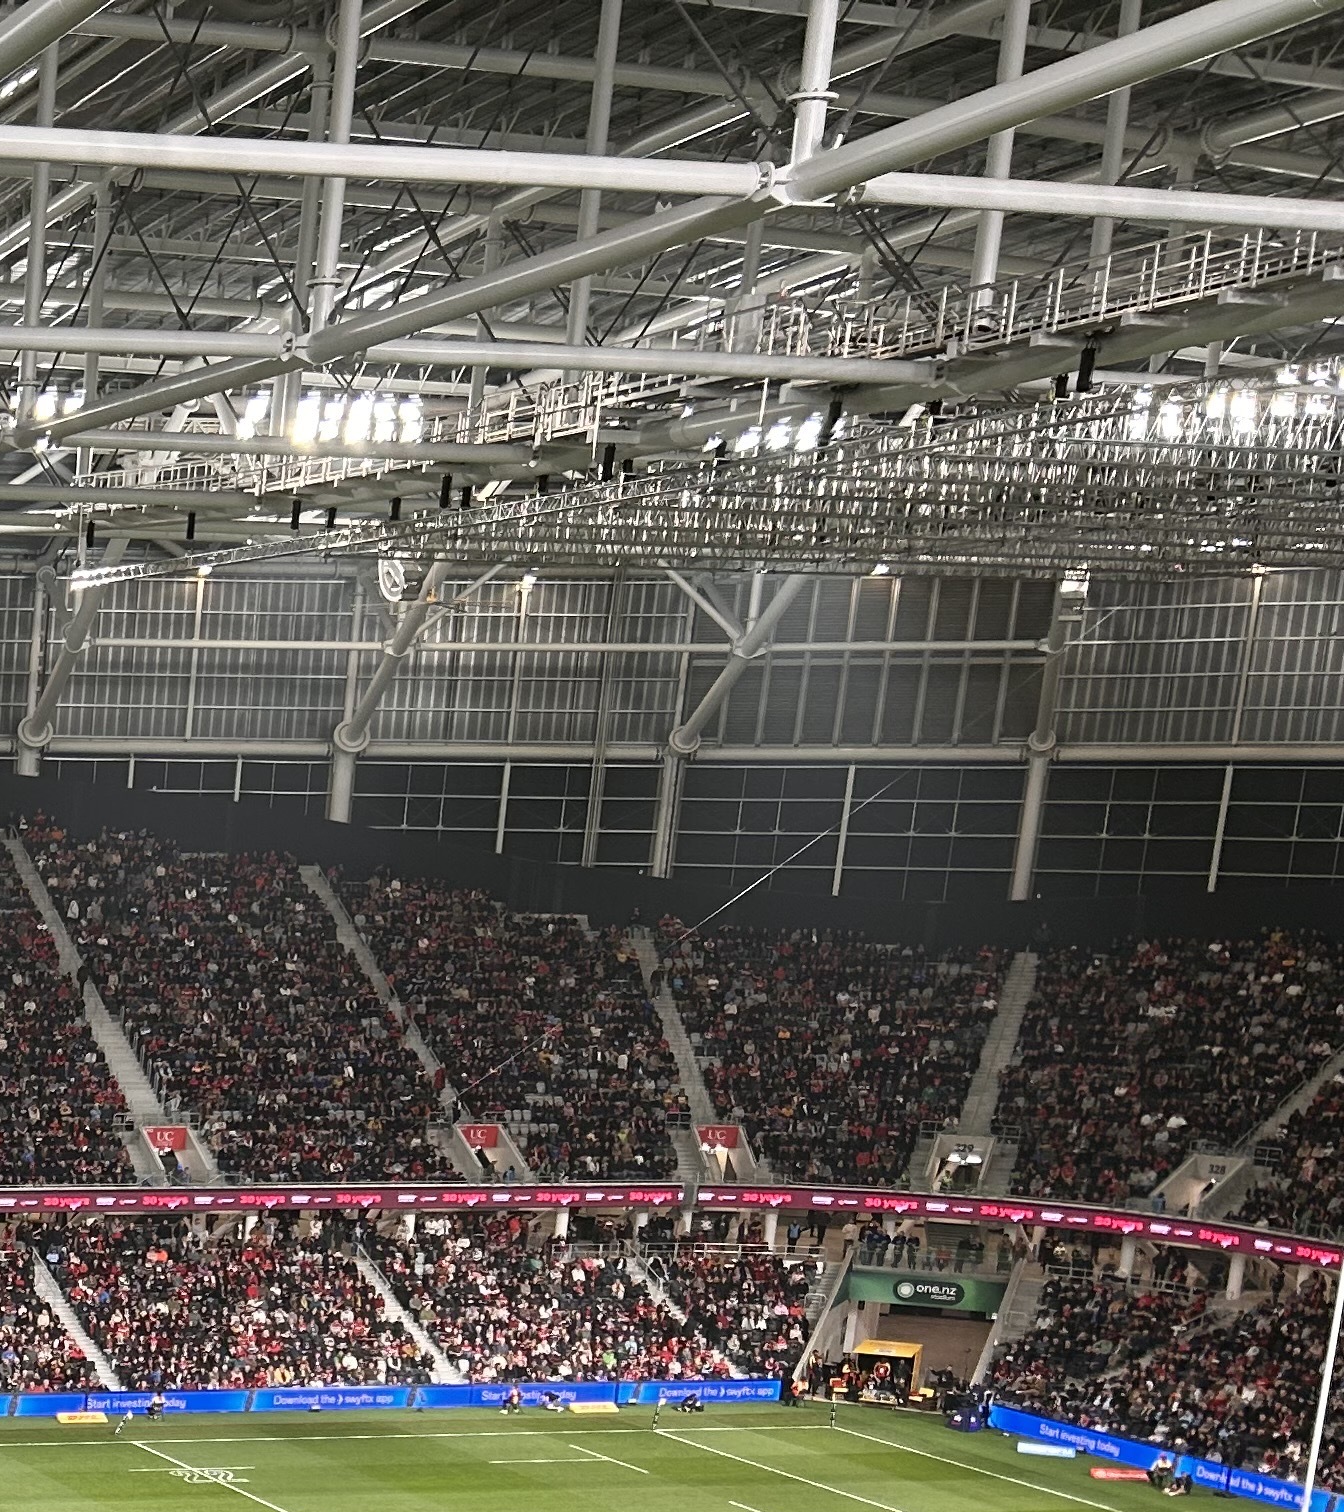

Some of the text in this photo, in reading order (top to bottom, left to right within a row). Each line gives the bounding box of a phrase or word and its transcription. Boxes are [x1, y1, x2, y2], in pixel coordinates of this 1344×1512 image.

[156, 1131, 174, 1141] UC
[470, 1129, 487, 1139] UC
[707, 1129, 726, 1140] UC
[916, 1284, 957, 1296] one.nz
[1040, 1424, 1060, 1440] Start
[1060, 1430, 1096, 1449] investing
